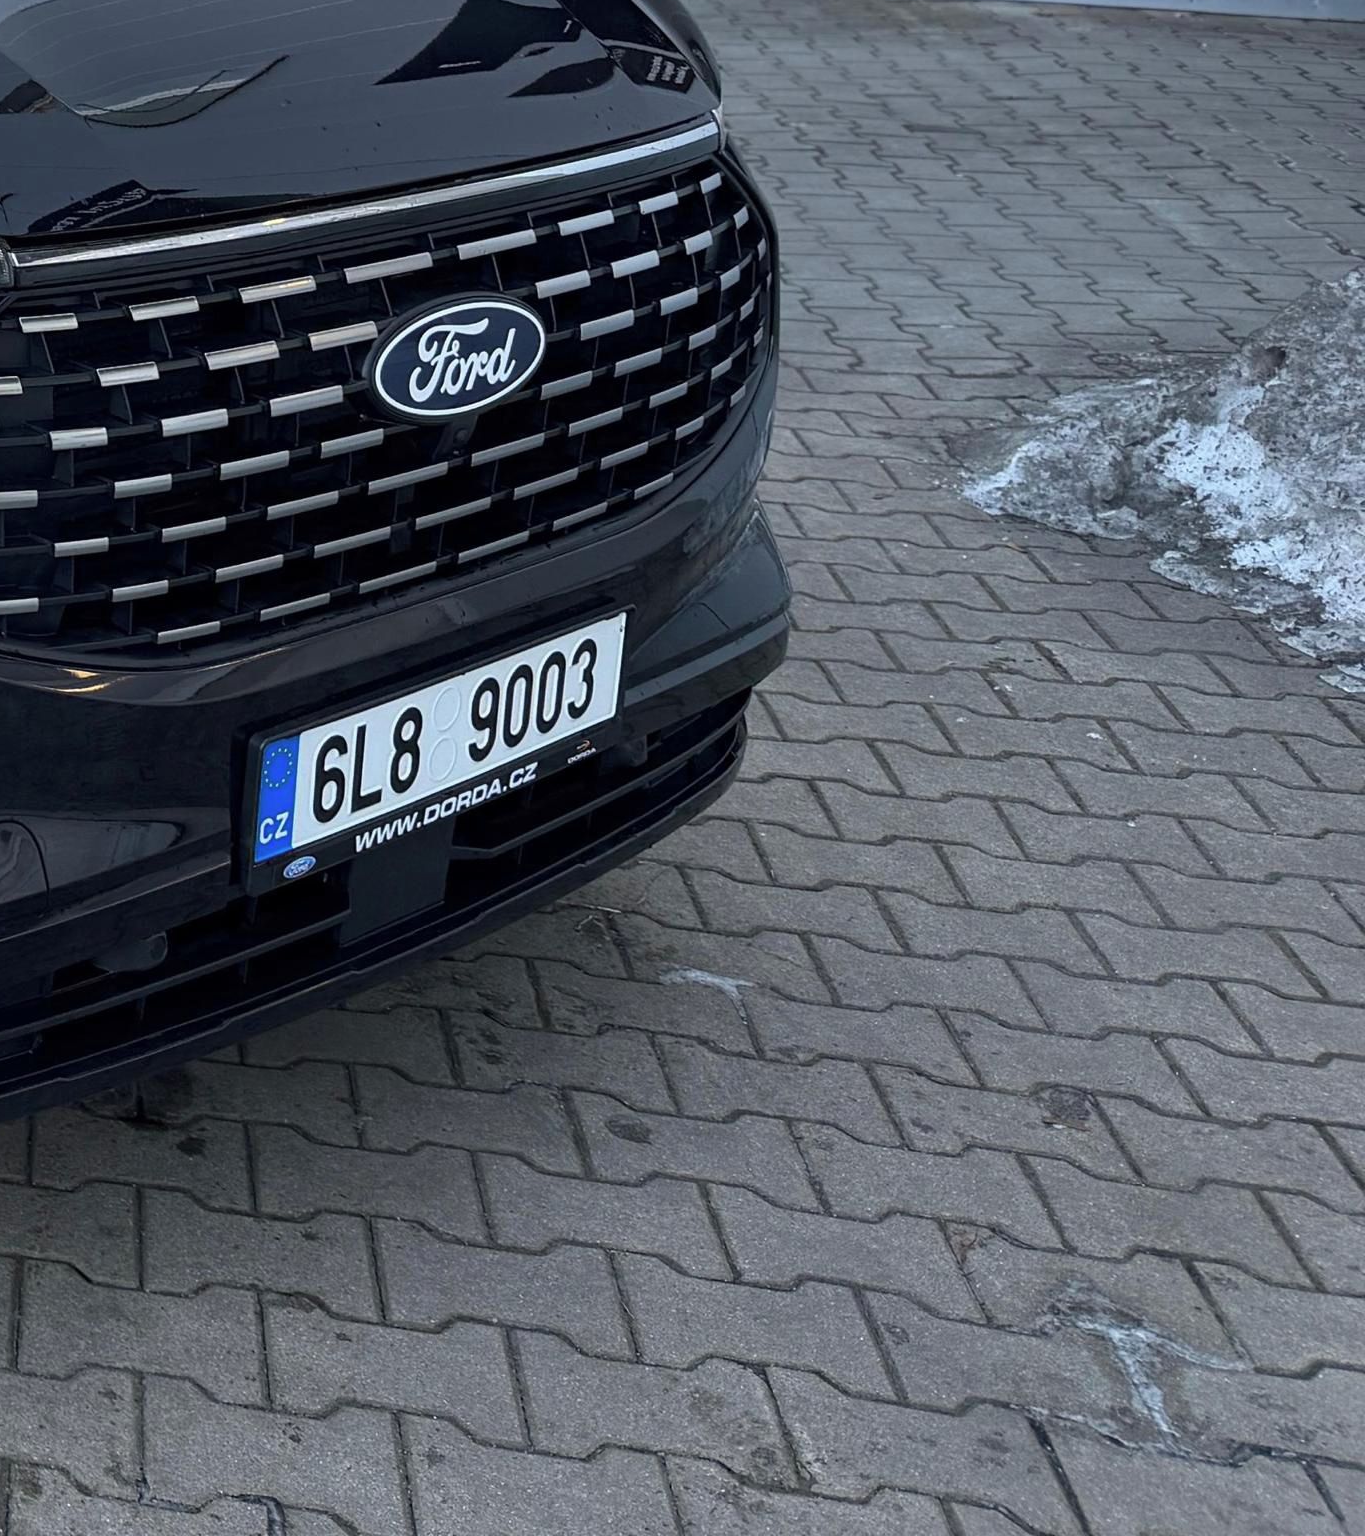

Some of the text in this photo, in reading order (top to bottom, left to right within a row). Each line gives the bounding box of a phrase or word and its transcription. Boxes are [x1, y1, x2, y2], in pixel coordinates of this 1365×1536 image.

[409, 317, 517, 403] Ford
[311, 638, 598, 825] 6L8 9003
[258, 811, 290, 846] CZ
[354, 761, 539, 854] WWW.DORDA.CZ
